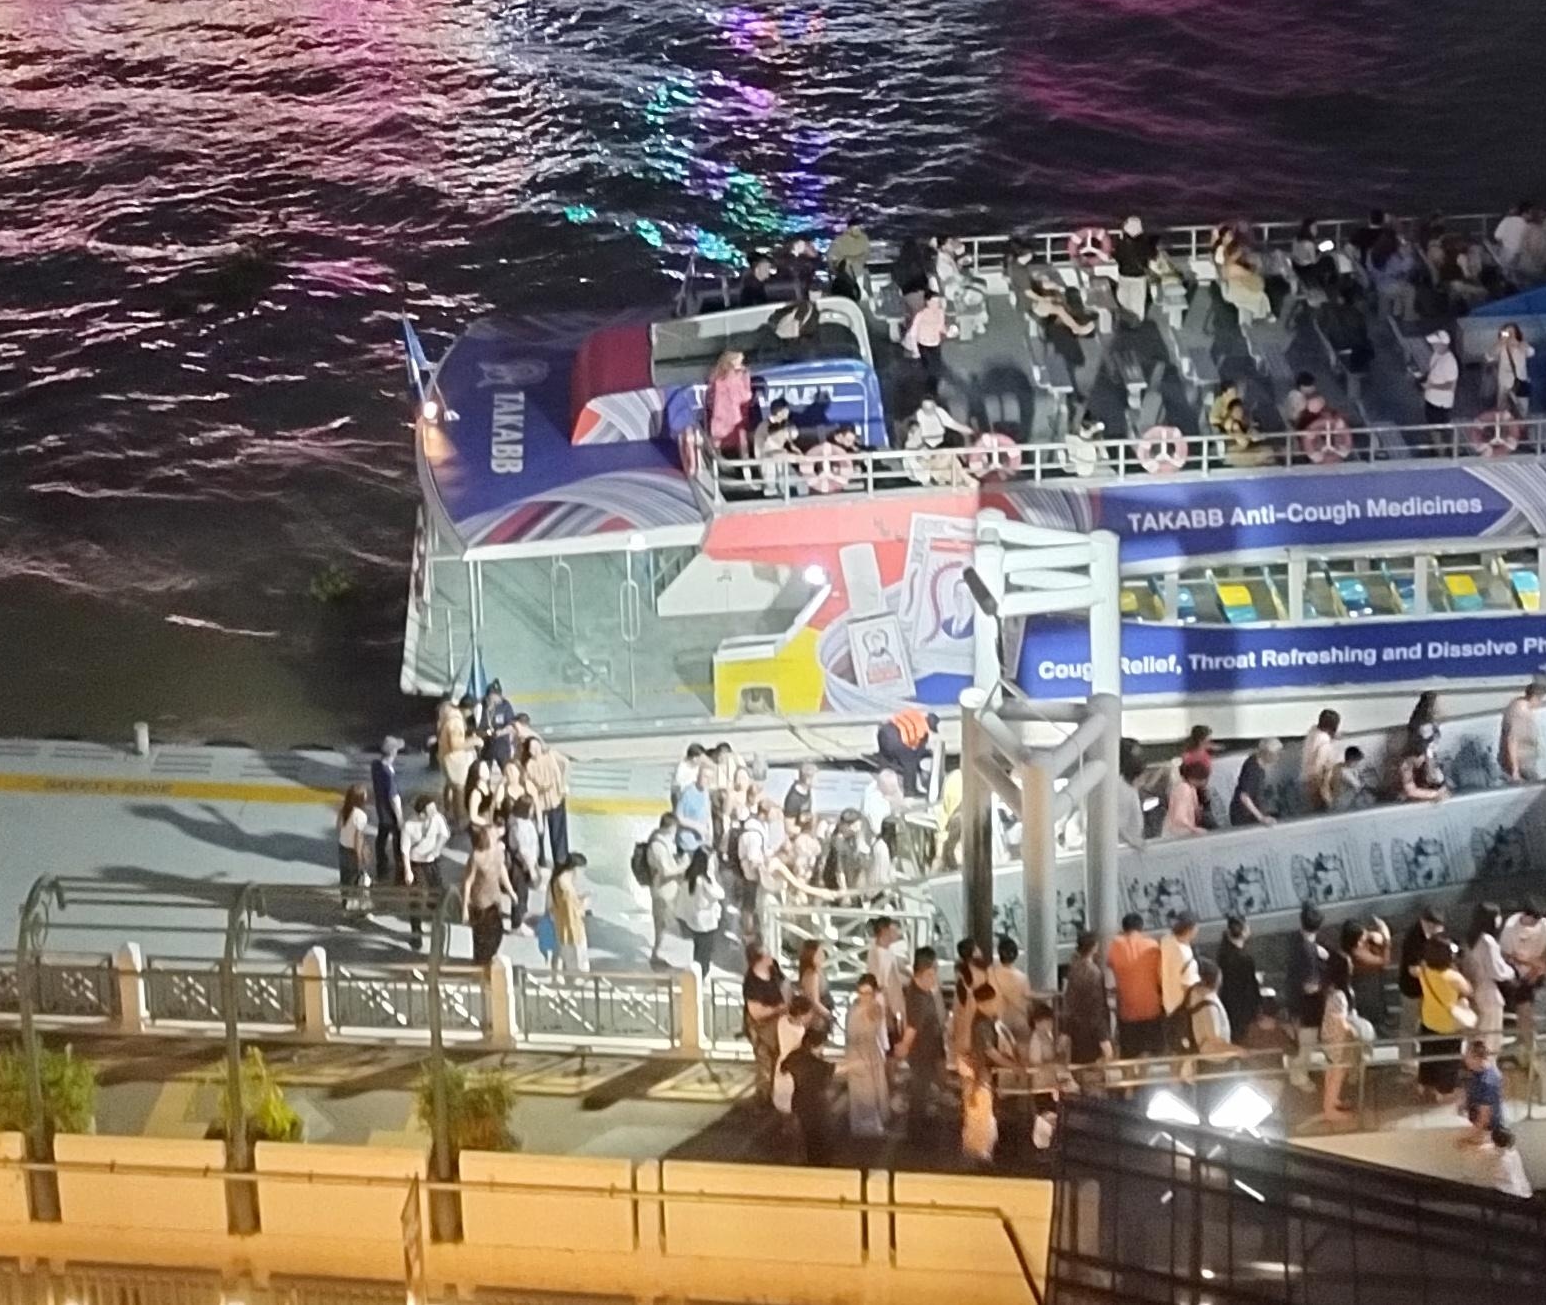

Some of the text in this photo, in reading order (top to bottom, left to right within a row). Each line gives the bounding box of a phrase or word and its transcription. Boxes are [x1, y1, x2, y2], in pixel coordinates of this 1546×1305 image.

[491, 391, 525, 473] TAKABB
[1127, 496, 1483, 533] TAKABB Anti-Cough Medicines
[1038, 659, 1093, 682] Coug
[1188, 650, 1257, 670] Throat
[1261, 645, 1376, 668] Refreshing
[1381, 642, 1422, 661] and
[1427, 638, 1518, 659] Dissolve
